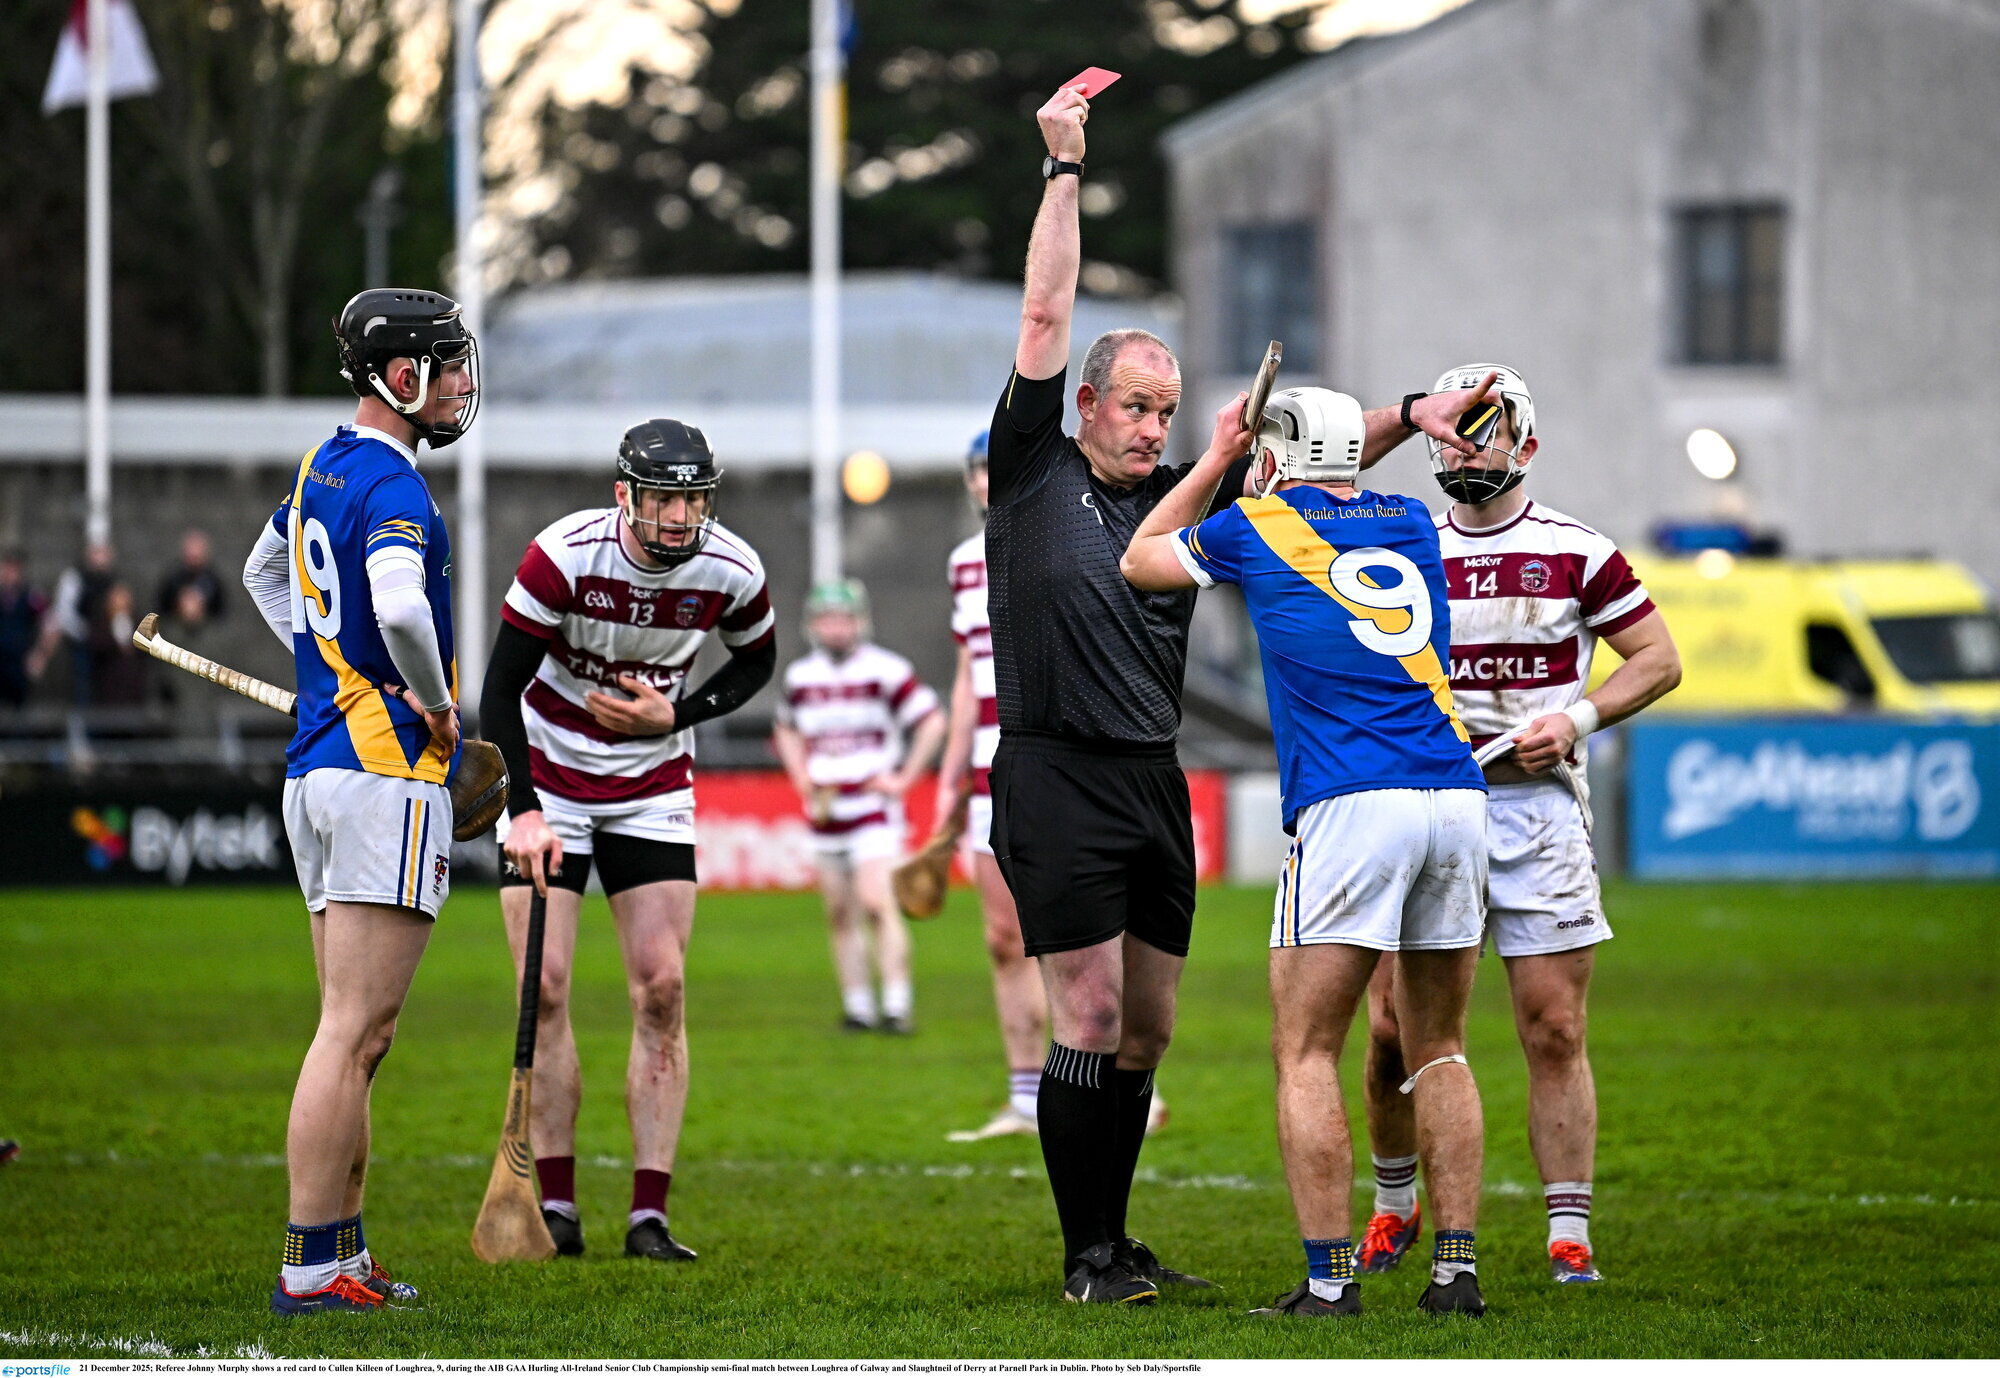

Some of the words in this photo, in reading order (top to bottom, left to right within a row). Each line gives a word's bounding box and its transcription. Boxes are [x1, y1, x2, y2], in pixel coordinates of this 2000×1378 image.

[1304, 507, 1336, 521] Baile
[1338, 505, 1374, 519] Locha
[1465, 571, 1499, 598] 14
[628, 602, 656, 627] 13
[1330, 547, 1434, 658] 9
[1557, 914, 1595, 930] oneills
